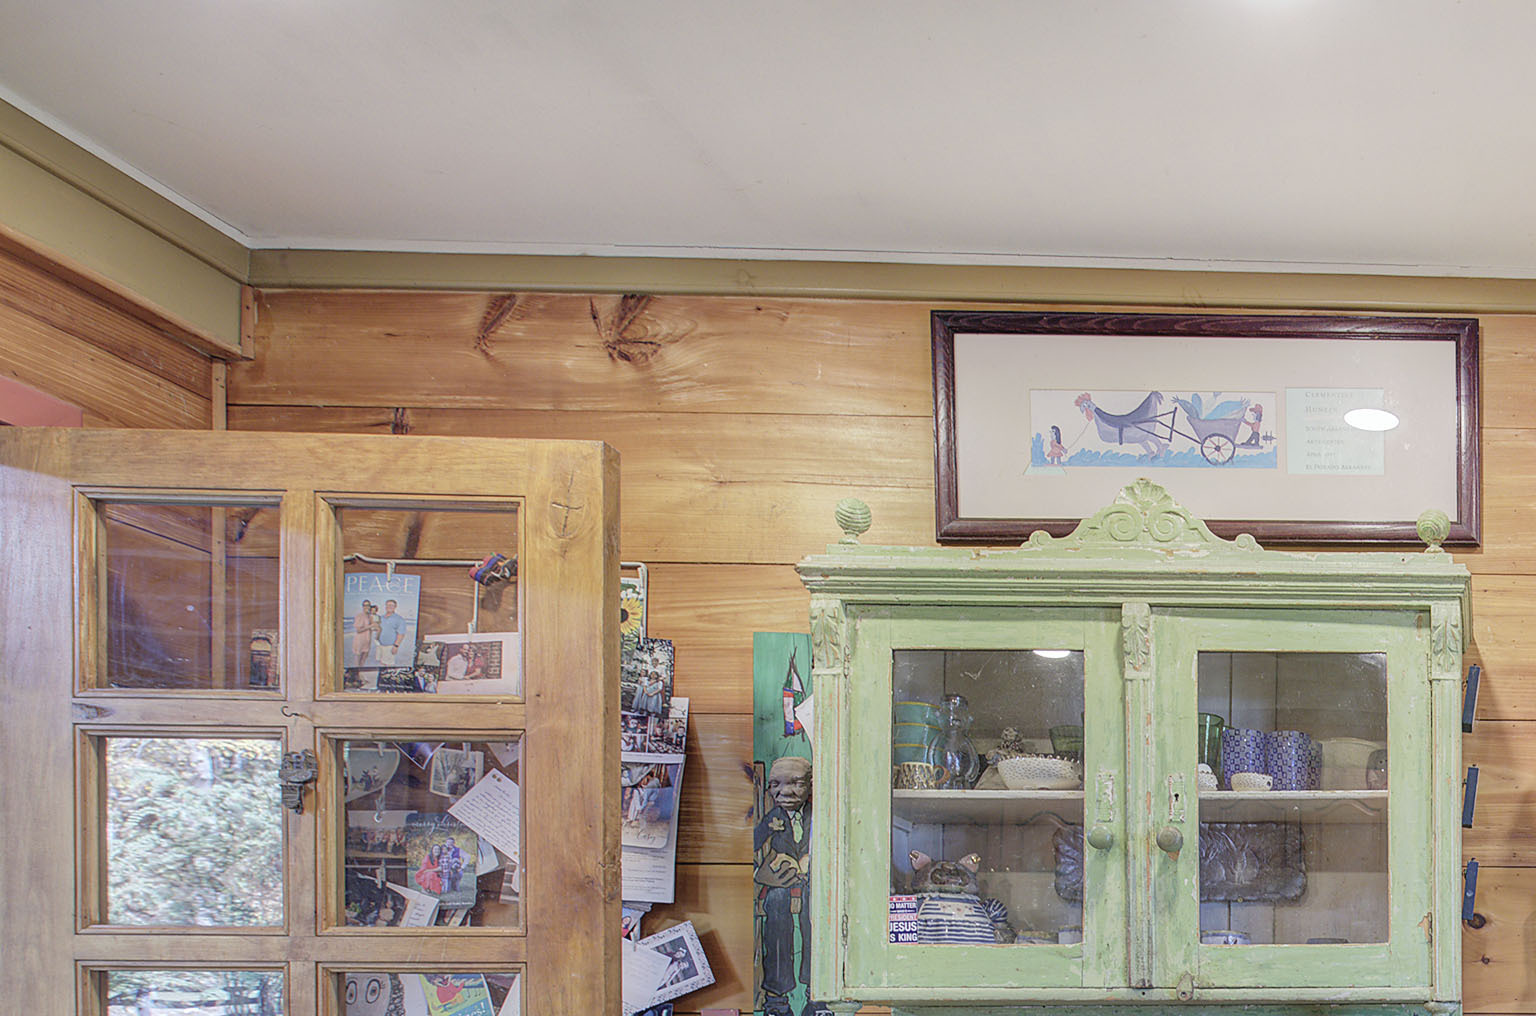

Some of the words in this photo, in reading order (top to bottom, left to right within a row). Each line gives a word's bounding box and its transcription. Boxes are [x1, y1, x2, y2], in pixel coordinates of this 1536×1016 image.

[346, 575, 417, 593] PEACE
[890, 934, 896, 942] S
[898, 933, 917, 942] KING
